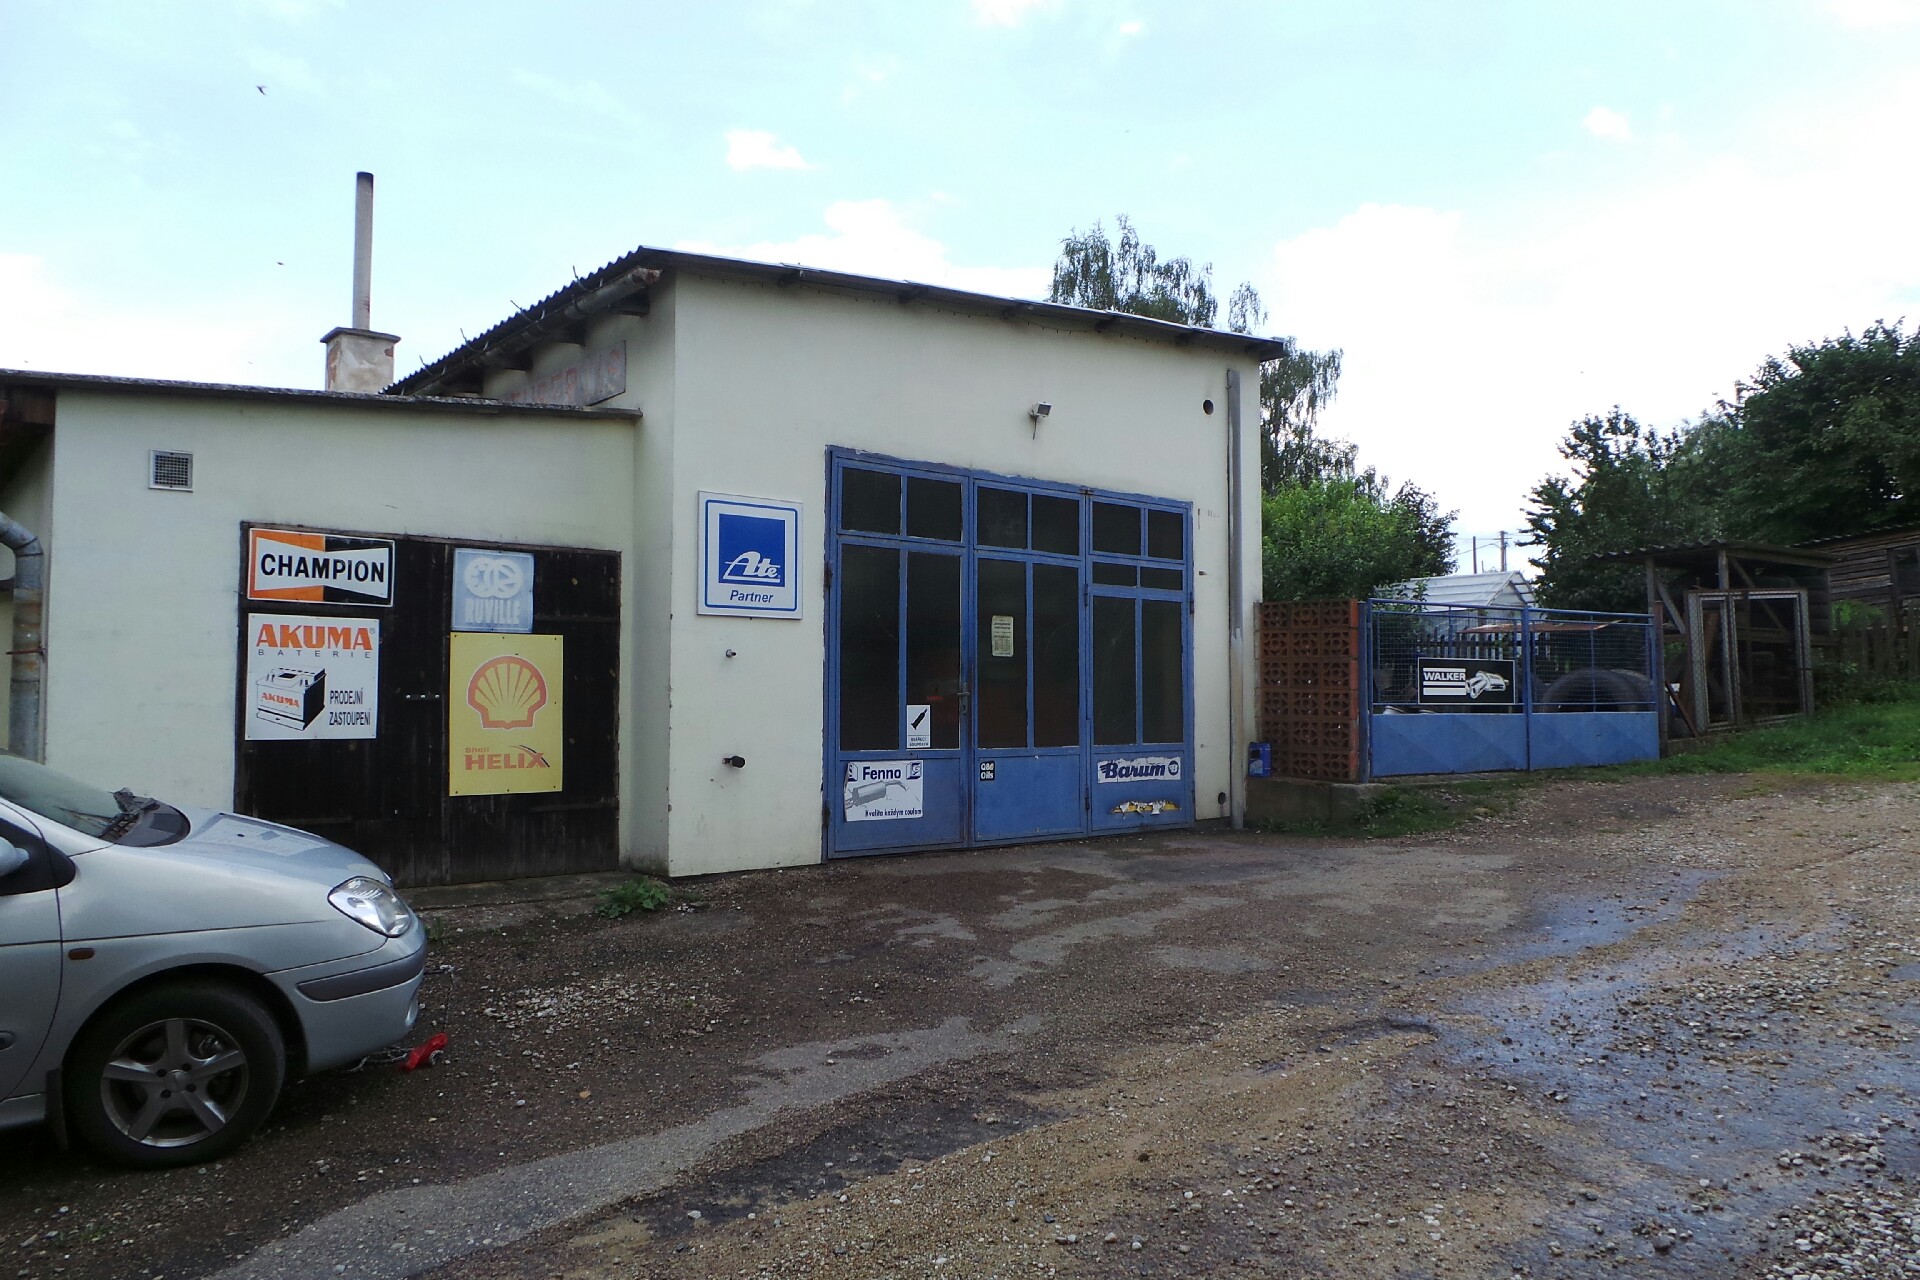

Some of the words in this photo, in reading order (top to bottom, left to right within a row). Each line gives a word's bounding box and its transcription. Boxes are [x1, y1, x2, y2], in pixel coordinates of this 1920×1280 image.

[260, 553, 384, 583] CHAMPION
[723, 551, 780, 583] Ate
[730, 590, 774, 603] Partner
[465, 599, 519, 625] RUVILLE
[256, 624, 373, 650] AKUMA
[258, 649, 371, 659] BATERIE
[1423, 672, 1466, 681] WALKER
[262, 692, 300, 708] AKUMA
[329, 687, 364, 705] PRODEJNÍ
[329, 707, 371, 726] ZASTOUPENÍ
[464, 752, 549, 771] HELIX
[1099, 761, 1166, 779] Barum
[863, 766, 901, 780] Fenno
